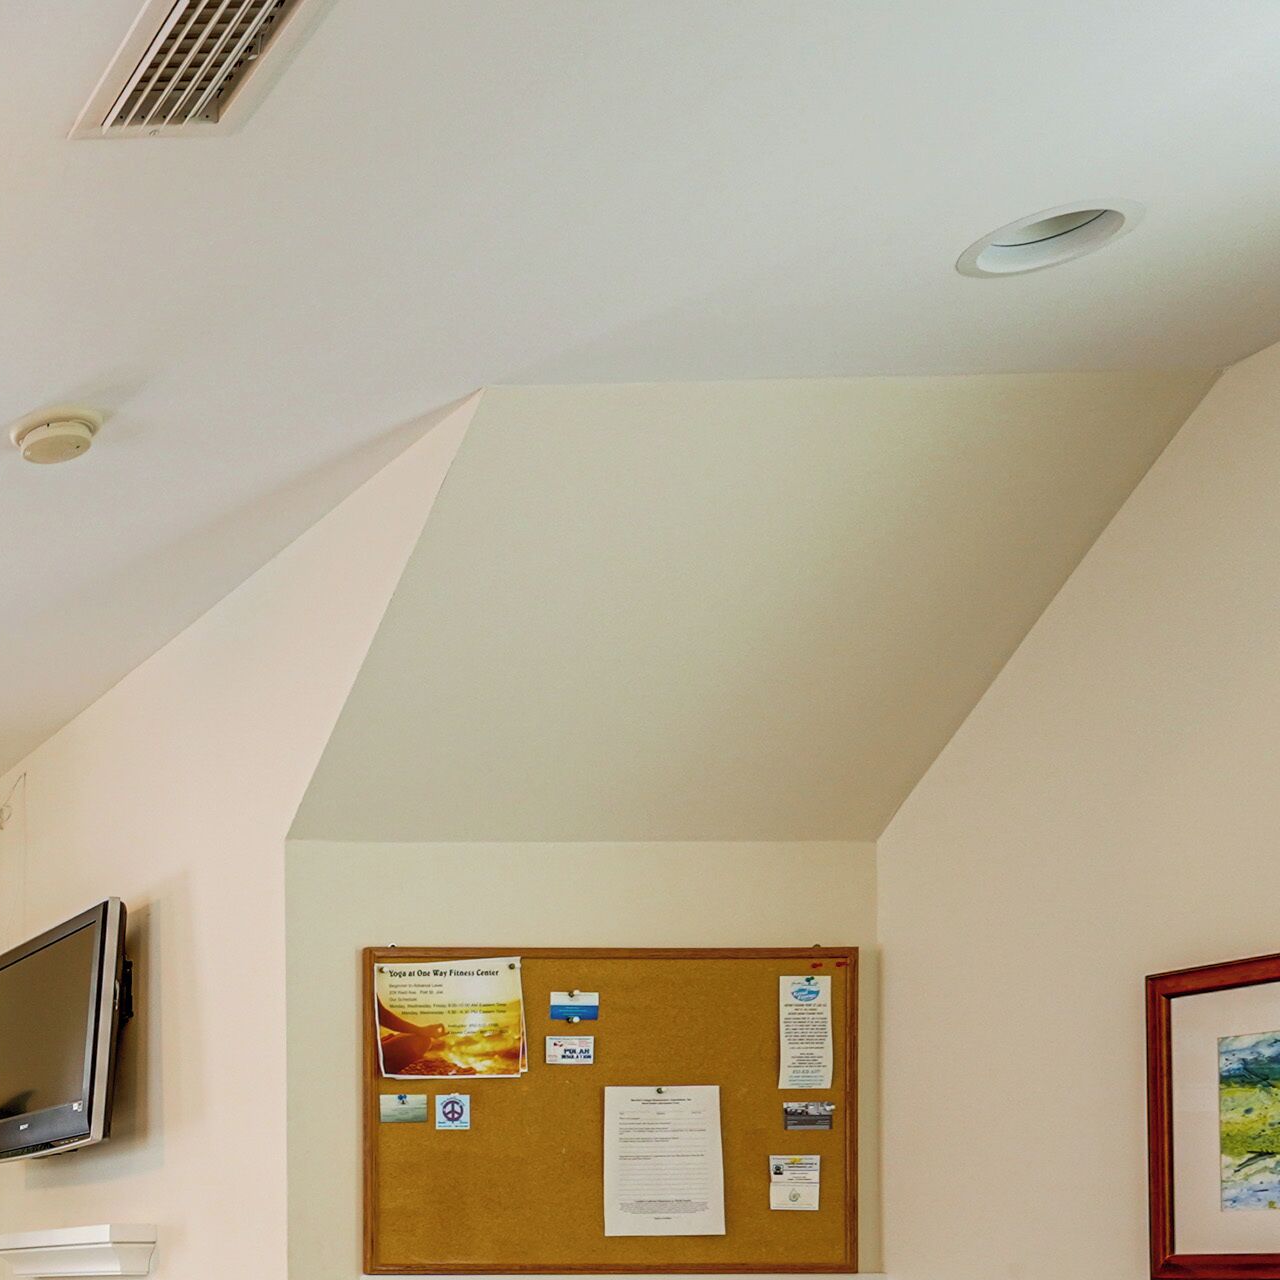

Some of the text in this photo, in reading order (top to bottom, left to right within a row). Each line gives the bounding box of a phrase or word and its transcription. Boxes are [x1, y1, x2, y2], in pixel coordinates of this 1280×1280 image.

[389, 969, 407, 978] Yoga
[417, 969, 430, 977] One
[432, 969, 447, 978] Way
[449, 969, 474, 977] Fitness
[476, 968, 499, 977] Center
